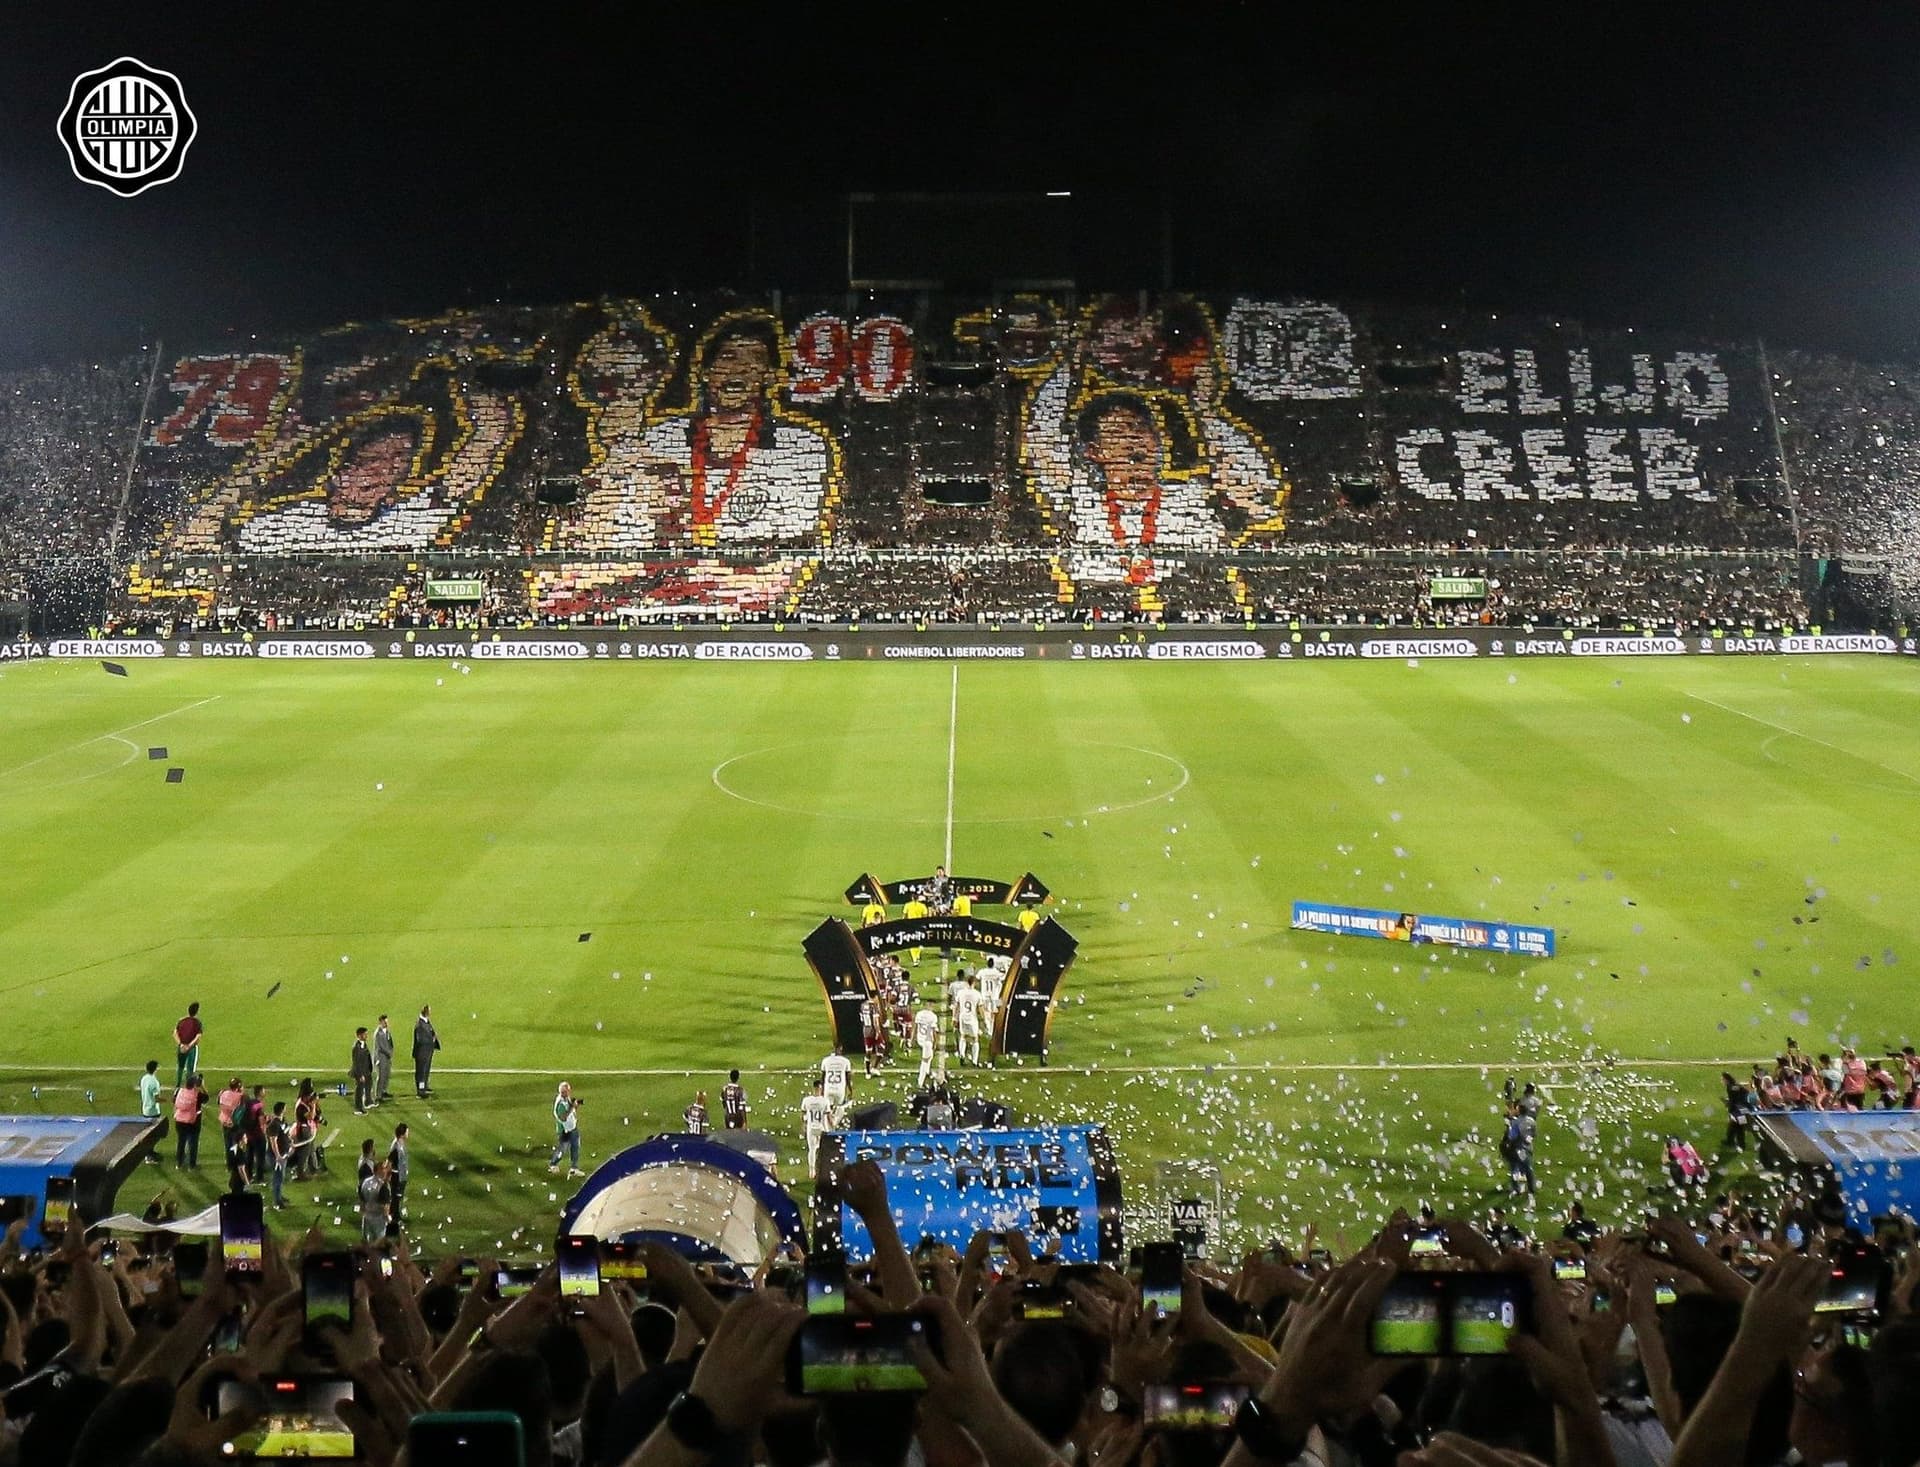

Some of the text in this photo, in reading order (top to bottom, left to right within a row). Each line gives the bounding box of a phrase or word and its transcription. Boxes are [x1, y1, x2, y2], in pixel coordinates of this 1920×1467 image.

[791, 312, 913, 402] 90
[1455, 348, 1729, 420] ELIJO
[145, 353, 290, 447] 79
[1396, 427, 1718, 502] CREER
[434, 584, 474, 596] SALIDA
[1438, 582, 1477, 594] SALIDA
[0, 643, 155, 658] ASTA DE RACISMO
[202, 643, 365, 657] BASTA DE RACISMO
[414, 643, 579, 657] BASTA DE RACISMO
[637, 644, 803, 658] BASTA DE RACISMO
[884, 646, 1025, 658] CONMEBOL LIBERTADORES
[1090, 644, 1256, 658] BASTA DE RACISMO
[1304, 642, 1468, 657] BASTA DE RACISMO
[1515, 640, 1677, 654] BASTA DE RACISMO
[1724, 638, 1887, 652] BASTA DE RACISMO
[969, 884, 995, 893] 2023
[870, 935, 883, 949] Rio
[886, 933, 895, 944] de
[927, 930, 974, 941] FINAL
[975, 933, 1012, 949] 2023
[985, 980, 995, 992] 11
[964, 1001, 972, 1013] 9
[827, 1070, 842, 1084] 23
[726, 1100, 736, 1114] 11
[810, 1110, 822, 1123] 14
[688, 1120, 700, 1134] 30
[1816, 1129, 1920, 1155] PO
[855, 1145, 1067, 1168] POWER
[956, 1165, 1073, 1188] ADE
[1173, 1205, 1208, 1219] VAR
